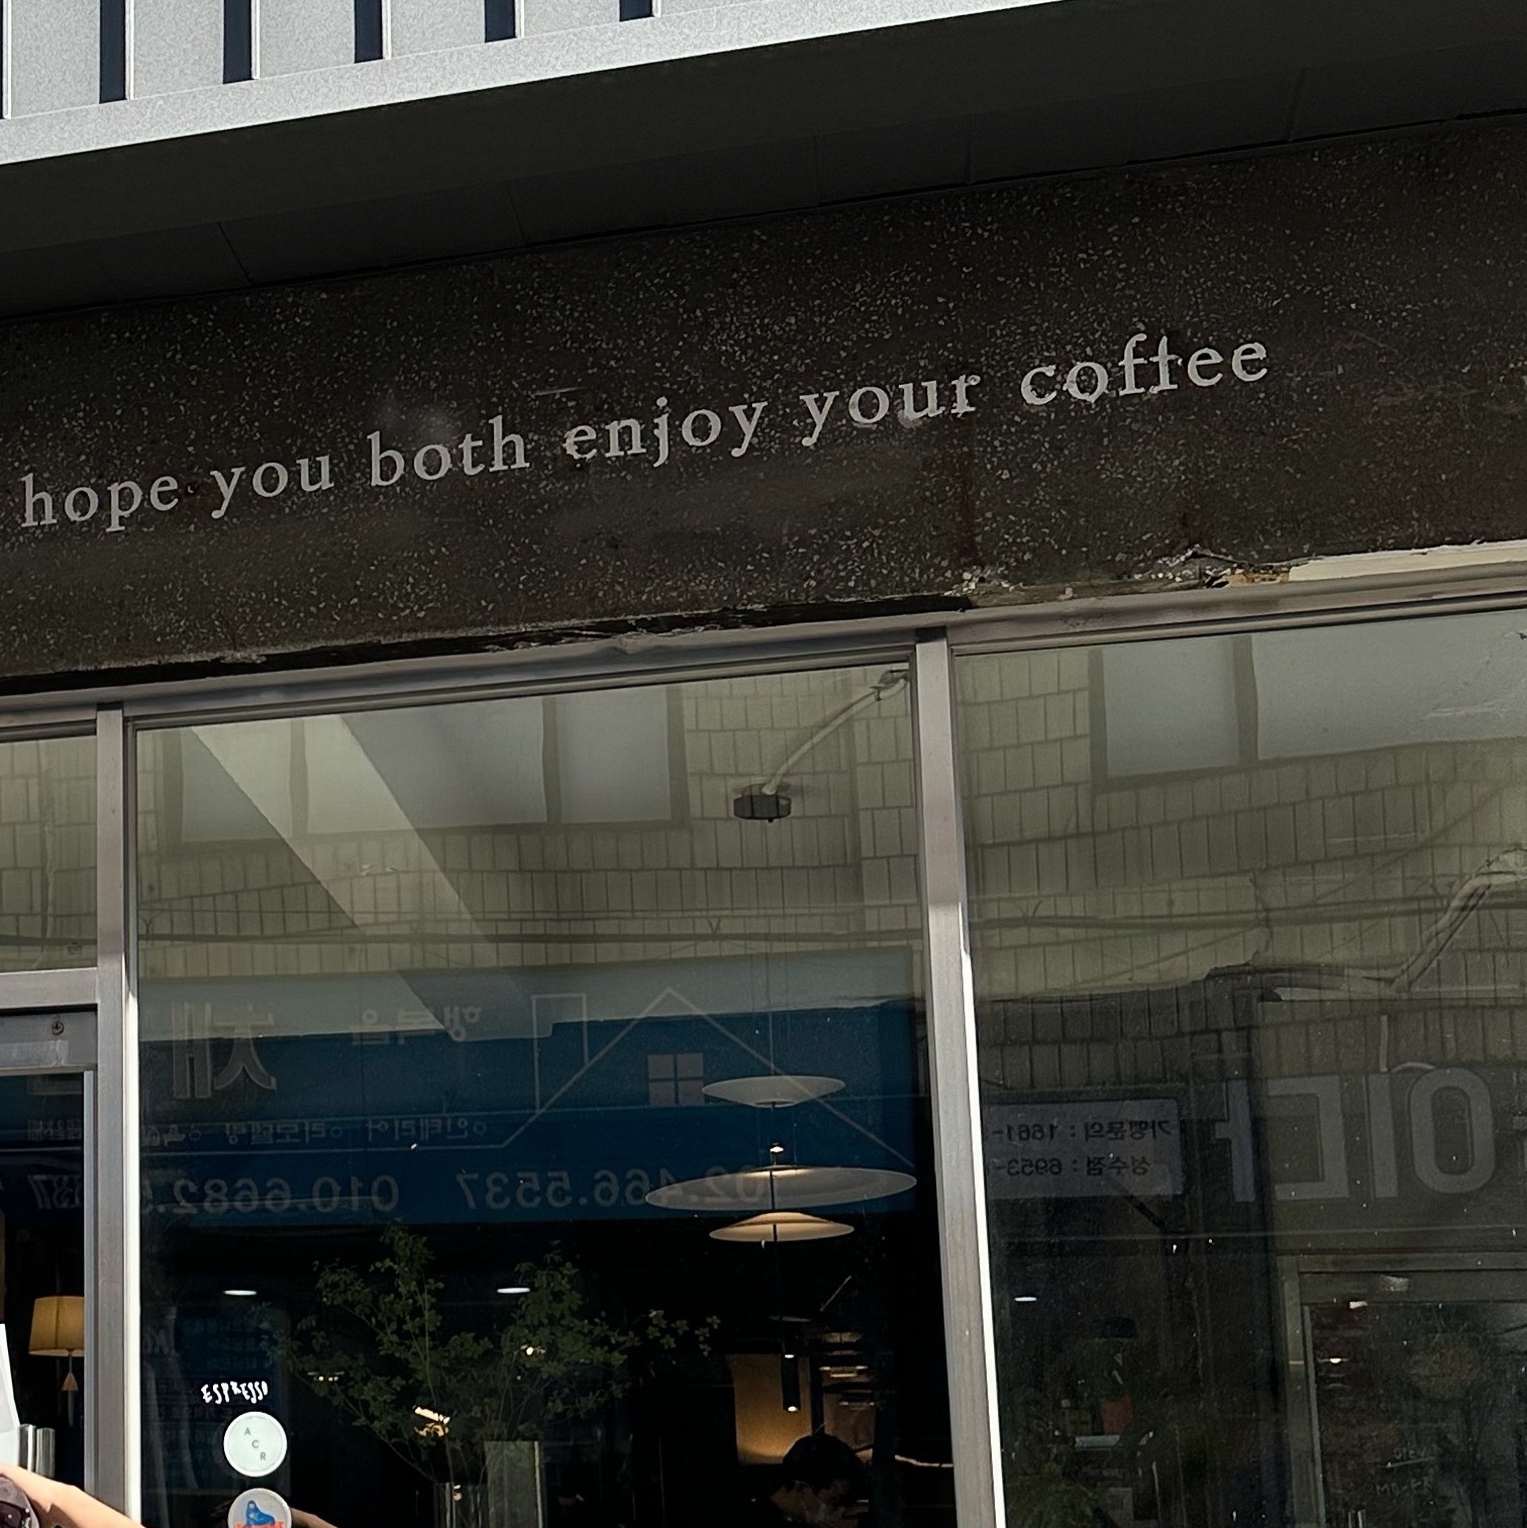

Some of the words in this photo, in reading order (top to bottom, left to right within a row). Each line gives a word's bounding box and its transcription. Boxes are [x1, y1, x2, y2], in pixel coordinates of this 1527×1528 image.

[21, 473, 179, 533] hope
[209, 455, 335, 519] you
[367, 414, 530, 487] both
[563, 396, 769, 468] enjoy
[799, 374, 982, 447] your
[201, 1381, 268, 1404] ESPRESSO
